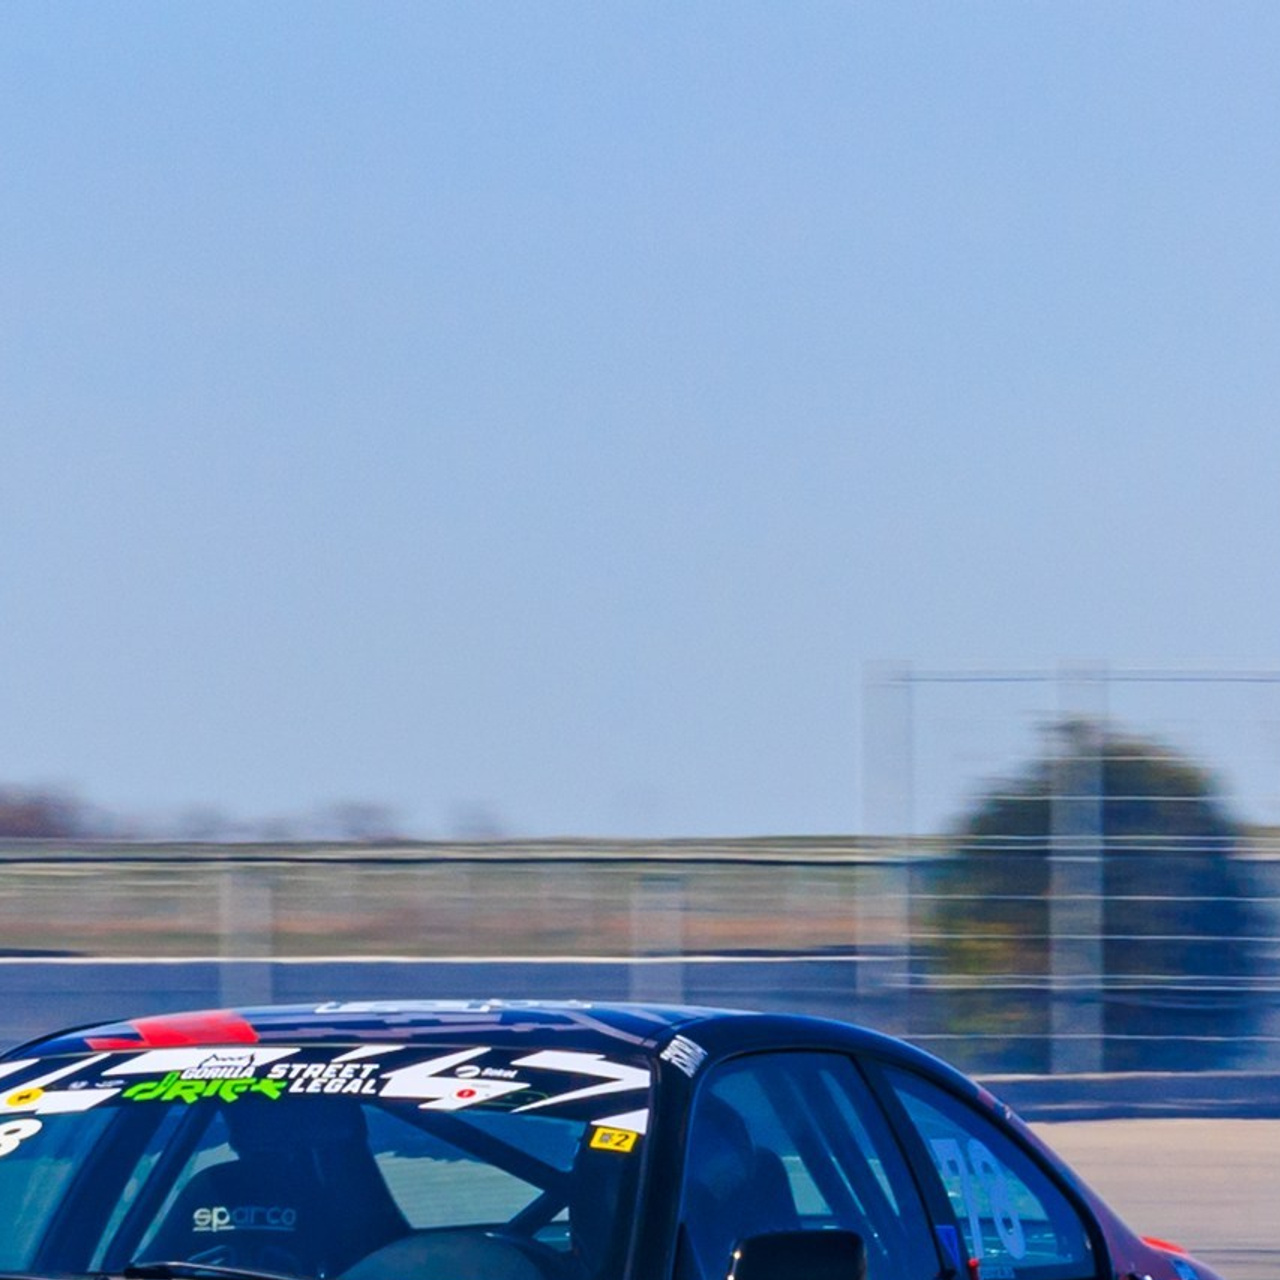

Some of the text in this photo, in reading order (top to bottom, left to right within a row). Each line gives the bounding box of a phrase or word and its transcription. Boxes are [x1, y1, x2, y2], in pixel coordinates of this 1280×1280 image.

[180, 1063, 380, 1080] GORILLA STREET
[288, 1078, 377, 1095] LEGAL
[929, 1138, 1026, 1260] 78
[193, 1206, 297, 1232] sparco
